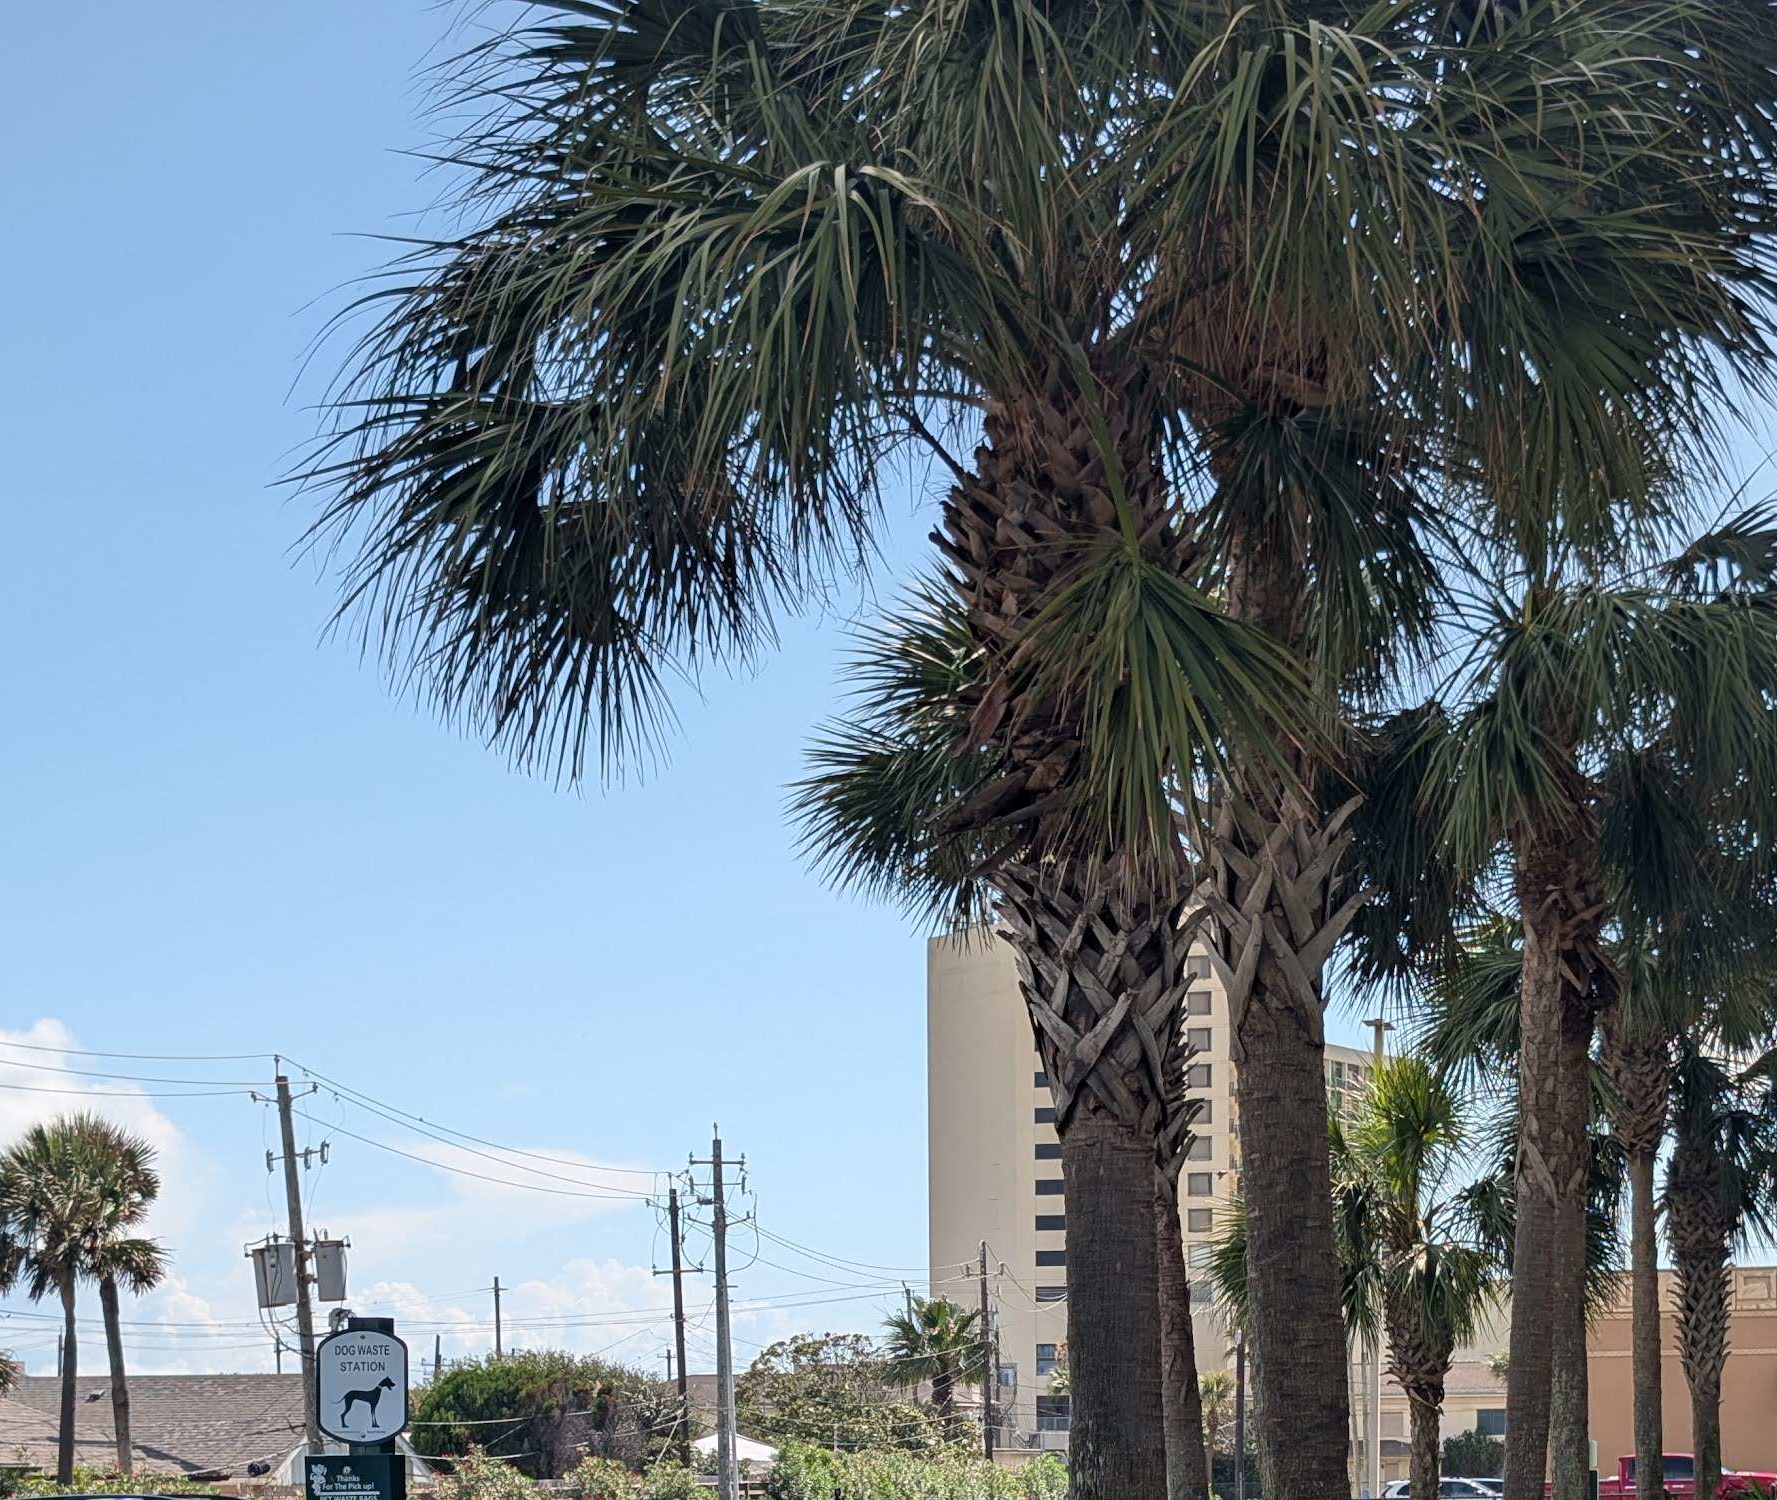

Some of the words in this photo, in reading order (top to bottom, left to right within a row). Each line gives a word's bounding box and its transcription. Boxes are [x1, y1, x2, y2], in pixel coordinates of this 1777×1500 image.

[334, 1345, 356, 1356] DOG
[357, 1344, 390, 1356] WASTE
[340, 1361, 386, 1372] STATION
[348, 1482, 362, 1490] Pick
[363, 1482, 375, 1491] up!
